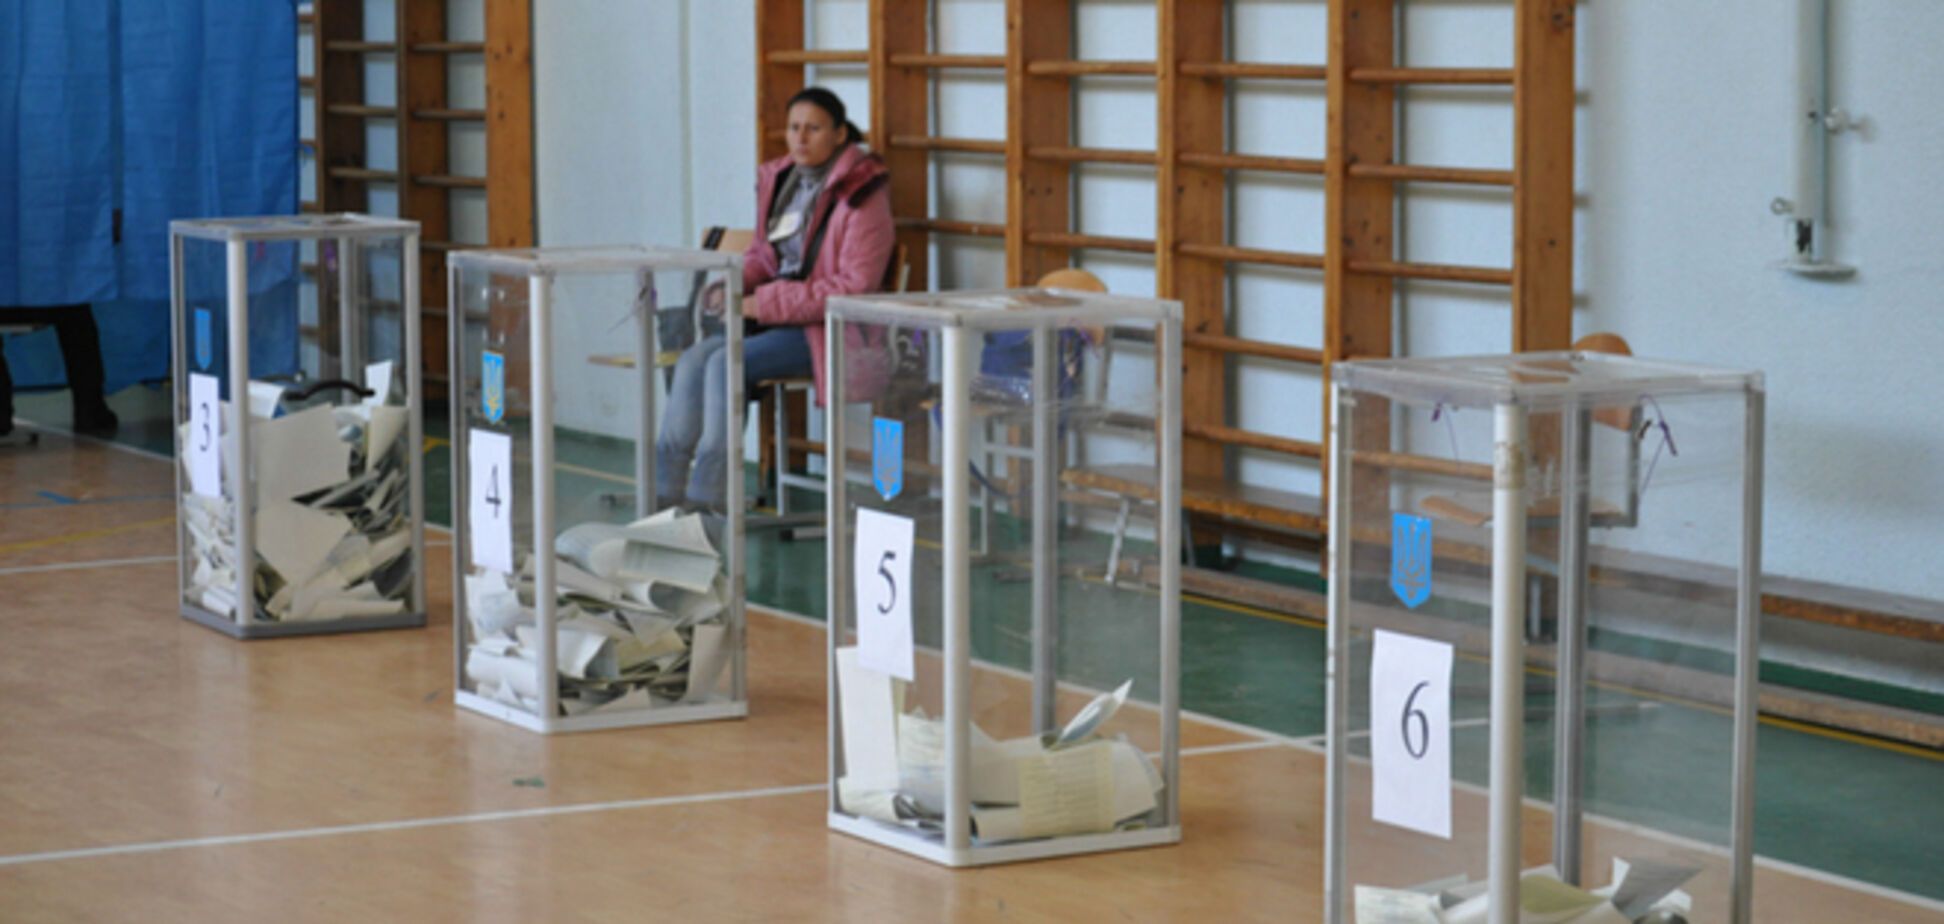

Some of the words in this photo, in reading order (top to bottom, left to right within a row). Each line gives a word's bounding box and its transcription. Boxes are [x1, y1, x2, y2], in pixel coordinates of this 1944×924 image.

[199, 402, 211, 452] 3
[485, 465, 502, 517] 4
[876, 551, 897, 614] 5
[1401, 681, 1429, 760] 6
